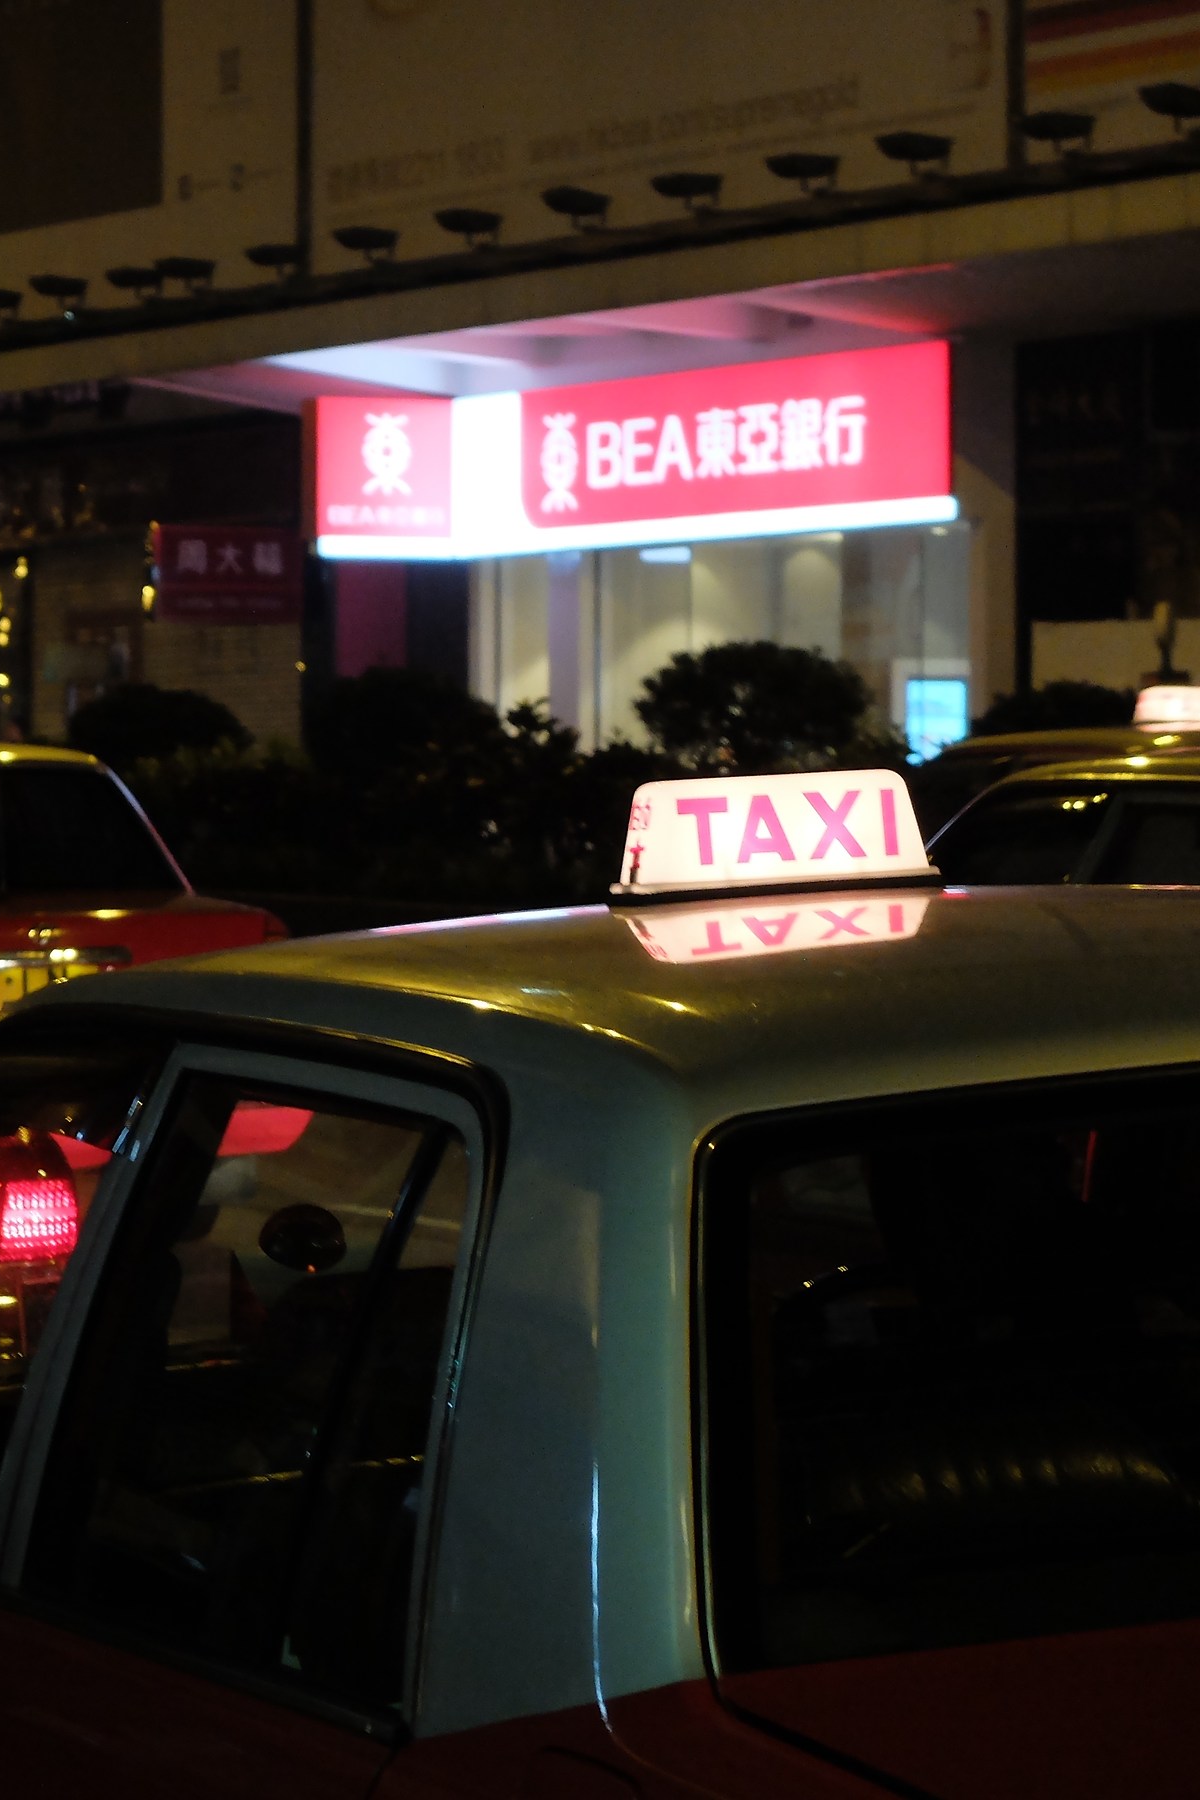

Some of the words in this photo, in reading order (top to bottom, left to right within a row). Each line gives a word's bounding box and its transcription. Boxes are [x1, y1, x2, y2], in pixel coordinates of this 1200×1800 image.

[586, 415, 694, 490] BEA
[696, 395, 867, 480] 東亞銀行
[677, 789, 899, 866] TAXI
